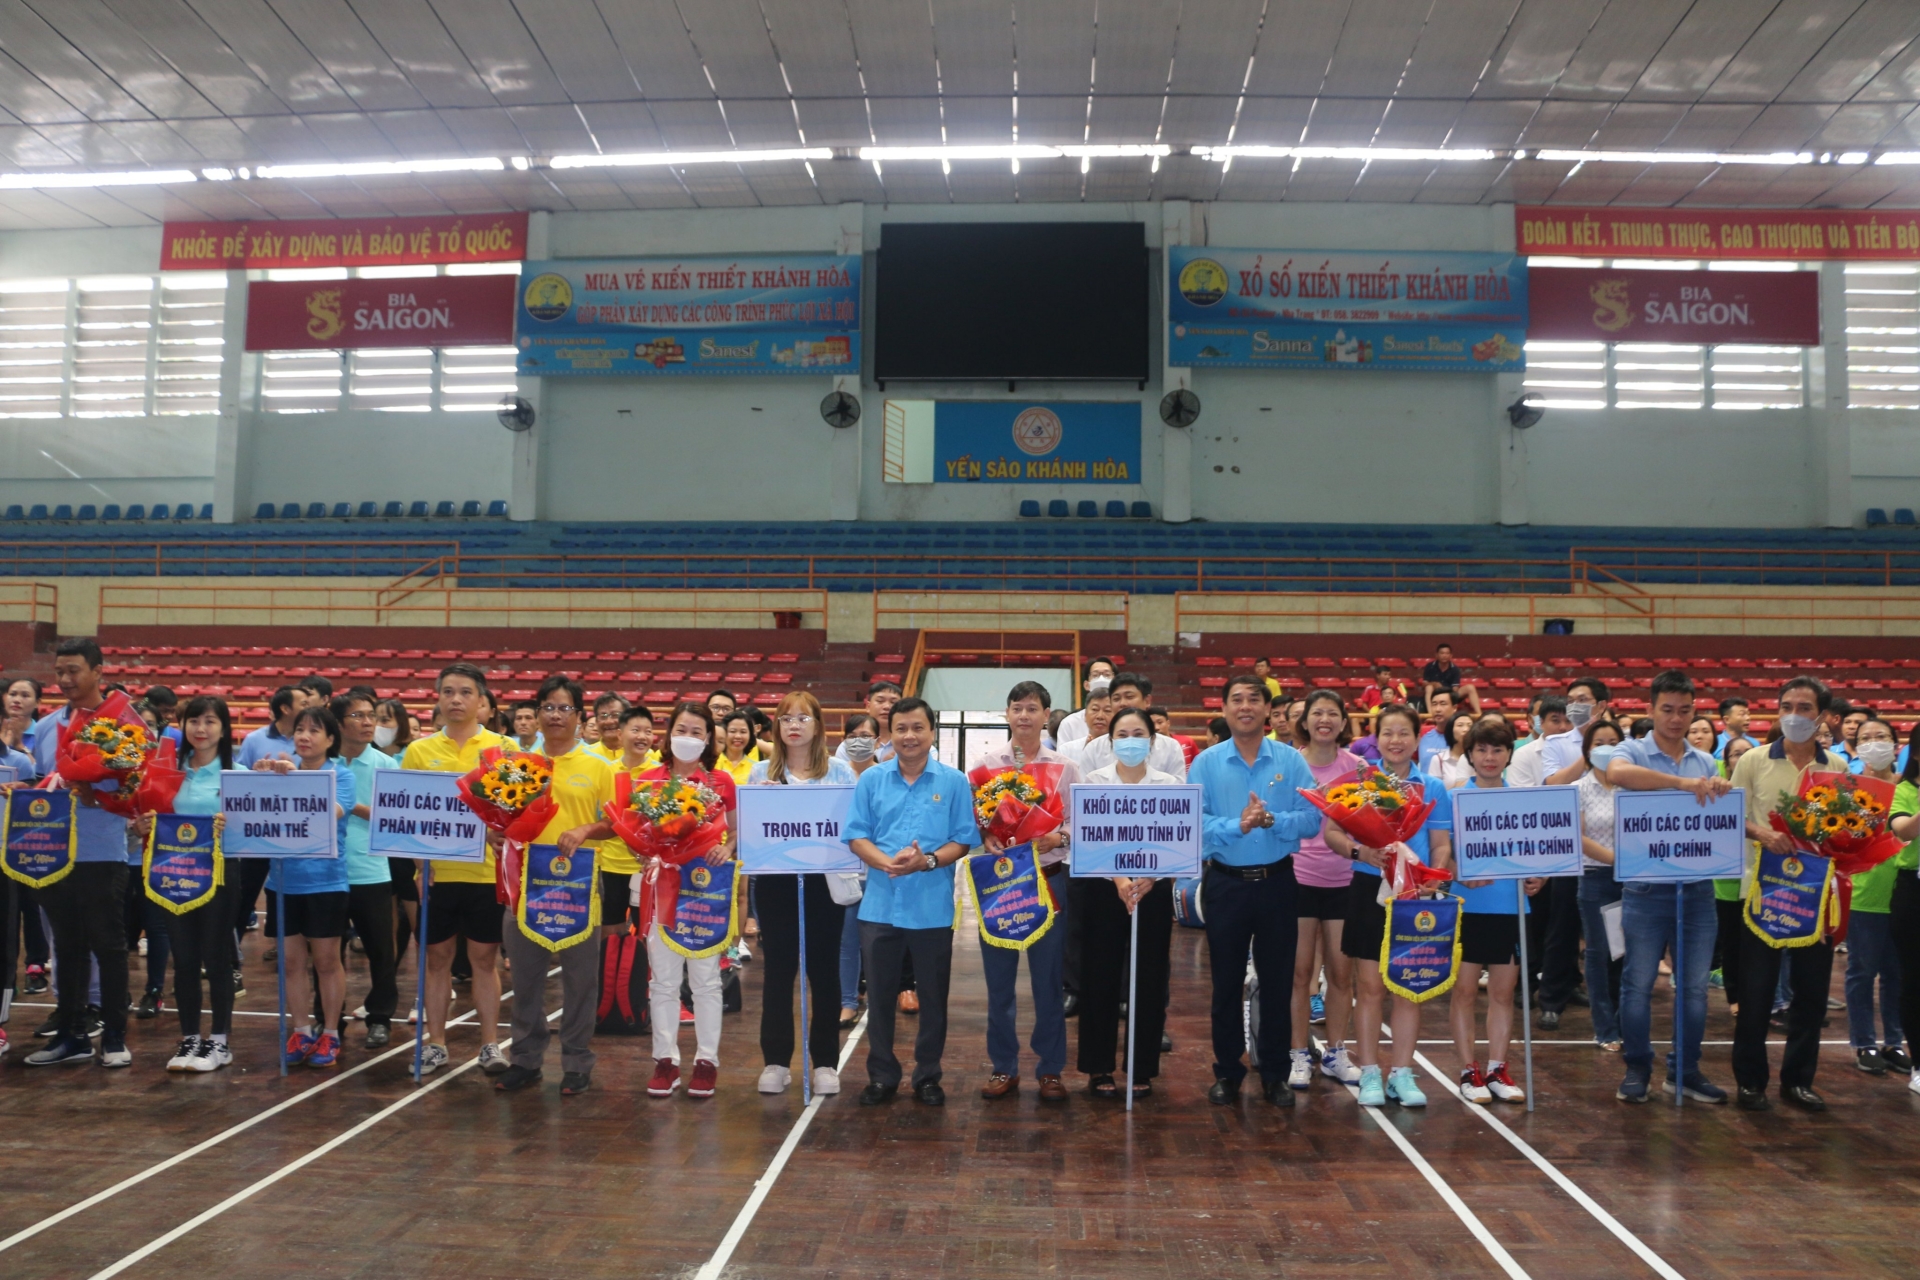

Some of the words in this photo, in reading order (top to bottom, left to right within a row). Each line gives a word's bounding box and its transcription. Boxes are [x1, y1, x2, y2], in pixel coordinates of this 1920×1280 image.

[171, 229, 217, 259] KHỎE
[222, 225, 248, 258] ĐỂ
[250, 230, 284, 258] XÂY
[288, 231, 337, 262] DỰNG
[342, 228, 363, 256] VÀ
[369, 225, 405, 255] BẢO
[410, 226, 432, 259] VỆ
[437, 219, 463, 254] TỔ
[465, 220, 512, 256] QUỐC
[1523, 217, 1567, 246] ĐOÀN
[1572, 213, 1607, 247] KẾT,
[1611, 221, 1664, 247] TRUNG
[1668, 221, 1716, 253] THỰC,
[1720, 224, 1753, 249] CAO
[1757, 221, 1824, 254] THƯỢNG
[1828, 220, 1850, 249] VÀ
[1854, 215, 1891, 249] TIẾN
[1896, 220, 1920, 254] BỘ
[585, 273, 620, 291] MUA
[624, 268, 646, 290] VÉ
[651, 264, 691, 290] KIẾN
[696, 263, 747, 289] THIẾT
[752, 265, 811, 289] KHÁNH
[816, 264, 851, 288] HÒA
[1239, 254, 1263, 297] XỔ
[1269, 258, 1293, 298] SỐ
[1298, 259, 1341, 298] KIẾN
[1346, 260, 1400, 299] THIẾT
[1406, 266, 1469, 300] KHÁNH
[1474, 267, 1512, 301] HÒA
[388, 293, 417, 307] BIA
[1680, 287, 1712, 300] BIA
[354, 307, 450, 330] SAIGON
[1644, 301, 1748, 325] SAIGON
[701, 339, 754, 357] Sanest
[1253, 331, 1312, 353] Sanna
[946, 454, 981, 479] YẾN
[986, 457, 1020, 479] SÀO
[1026, 457, 1086, 479] KHÁNH
[1092, 456, 1129, 479] HÒA
[225, 792, 256, 812] KHỐI
[260, 796, 288, 816] MẶT
[293, 794, 328, 816] TRẬN
[378, 789, 410, 809] KHỐI
[414, 792, 441, 811] CÁC
[1083, 792, 1111, 815] KHỐI
[1114, 795, 1137, 815] CÁC
[1140, 797, 1157, 815] CƠ
[1159, 798, 1190, 816] QUAN
[244, 819, 281, 838] ĐOÀN
[285, 817, 310, 838] THỂ
[379, 817, 416, 835] PHÂN
[420, 819, 451, 840] VIỆN
[455, 823, 476, 839] TW
[762, 822, 811, 841] TRỌNG
[816, 818, 838, 837] TÀI
[1081, 826, 1114, 842] THAM
[1117, 824, 1144, 842] MƯU
[1147, 821, 1173, 842] TỈNH
[1177, 821, 1191, 842] ỦY
[1465, 809, 1492, 832] KHỐI
[1495, 811, 1519, 830] CÁC
[1522, 812, 1538, 829] CƠ
[1540, 811, 1571, 830] QUAN
[1623, 811, 1652, 833] KHỐI
[1656, 812, 1680, 832] CÁC
[1684, 813, 1701, 831] CƠ
[1704, 814, 1737, 832] QUAN
[1114, 848, 1146, 871] (KHỐI
[1149, 853, 1158, 871] I)
[1465, 837, 1497, 860] QUẢN
[1501, 837, 1513, 857] LÝ
[1516, 837, 1535, 856] TÀI
[1538, 836, 1574, 856] CHÍNH
[1649, 839, 1670, 862] NỘI
[1673, 838, 1711, 858] CHÍNH
